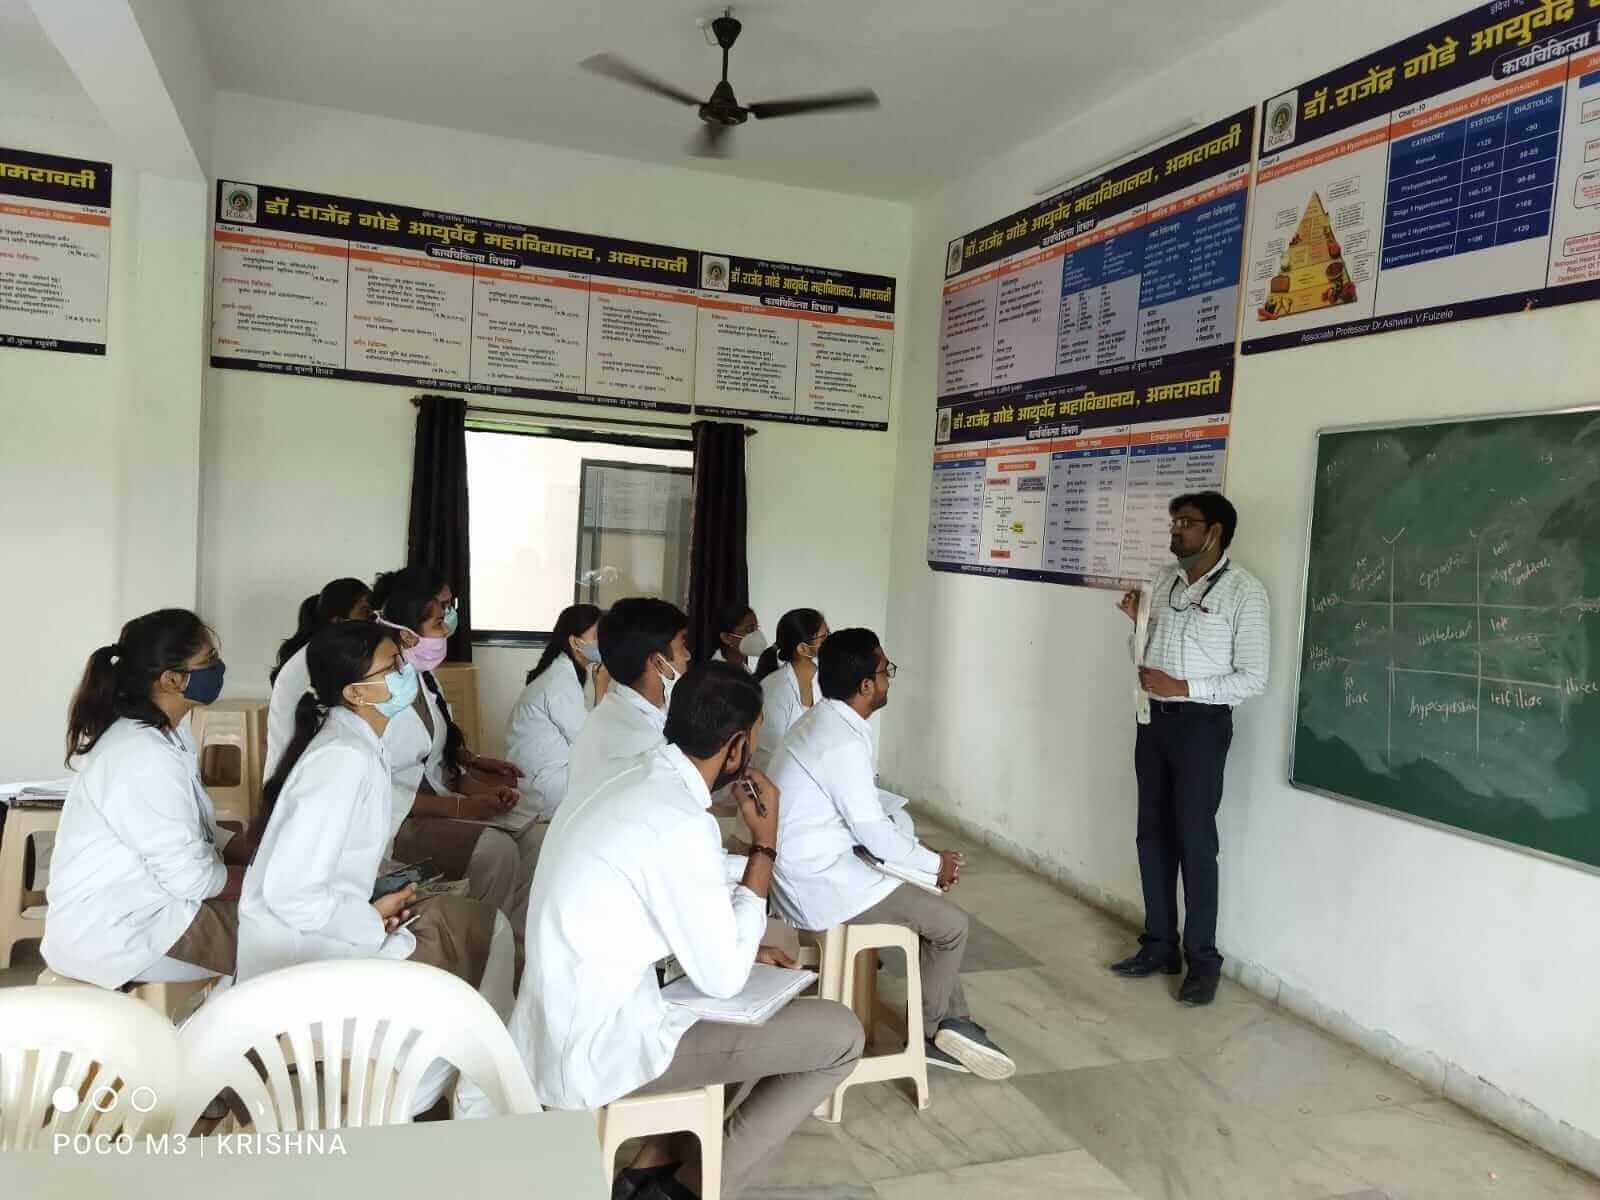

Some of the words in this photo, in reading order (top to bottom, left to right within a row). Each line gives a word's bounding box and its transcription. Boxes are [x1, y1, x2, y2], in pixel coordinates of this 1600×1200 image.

[1403, 35, 1460, 80] गोडे
[1502, 33, 1590, 73] कायचिकित्सा
[1480, 79, 1539, 105] Hypertension
[1006, 217, 1028, 238] गोडे
[1032, 202, 1071, 232] आयुर्वेद
[1164, 124, 1241, 175] अमरावती
[358, 211, 401, 232] गोडे
[407, 219, 477, 245] आयुर्वेद
[607, 249, 689, 273] अमरावती
[1017, 399, 1056, 425] आयुर्वेद
[1145, 370, 1222, 403] अमरावती
